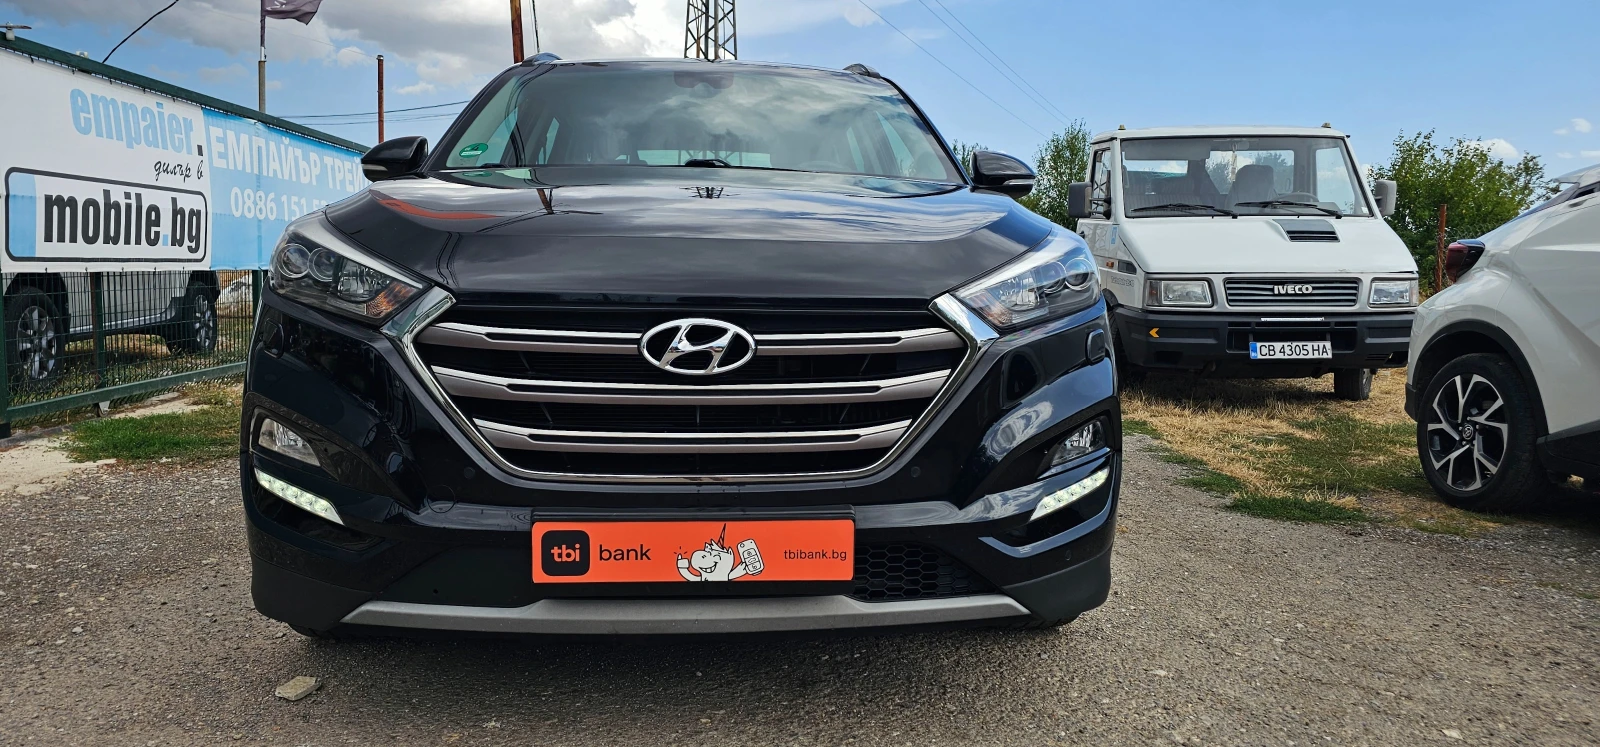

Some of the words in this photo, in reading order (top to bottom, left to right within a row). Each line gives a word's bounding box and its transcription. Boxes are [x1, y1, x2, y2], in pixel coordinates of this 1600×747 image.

[209, 125, 321, 186] ЕМПАЙЪР
[323, 155, 373, 193] ТРЕЙ
[230, 186, 277, 221] 0886
[44, 188, 202, 254] mobile.bg
[1273, 285, 1313, 295] IVECO
[1279, 344, 1309, 357] 4305
[550, 543, 581, 562] tbi
[599, 544, 652, 561] bank
[783, 548, 848, 561] tbibank.bg
